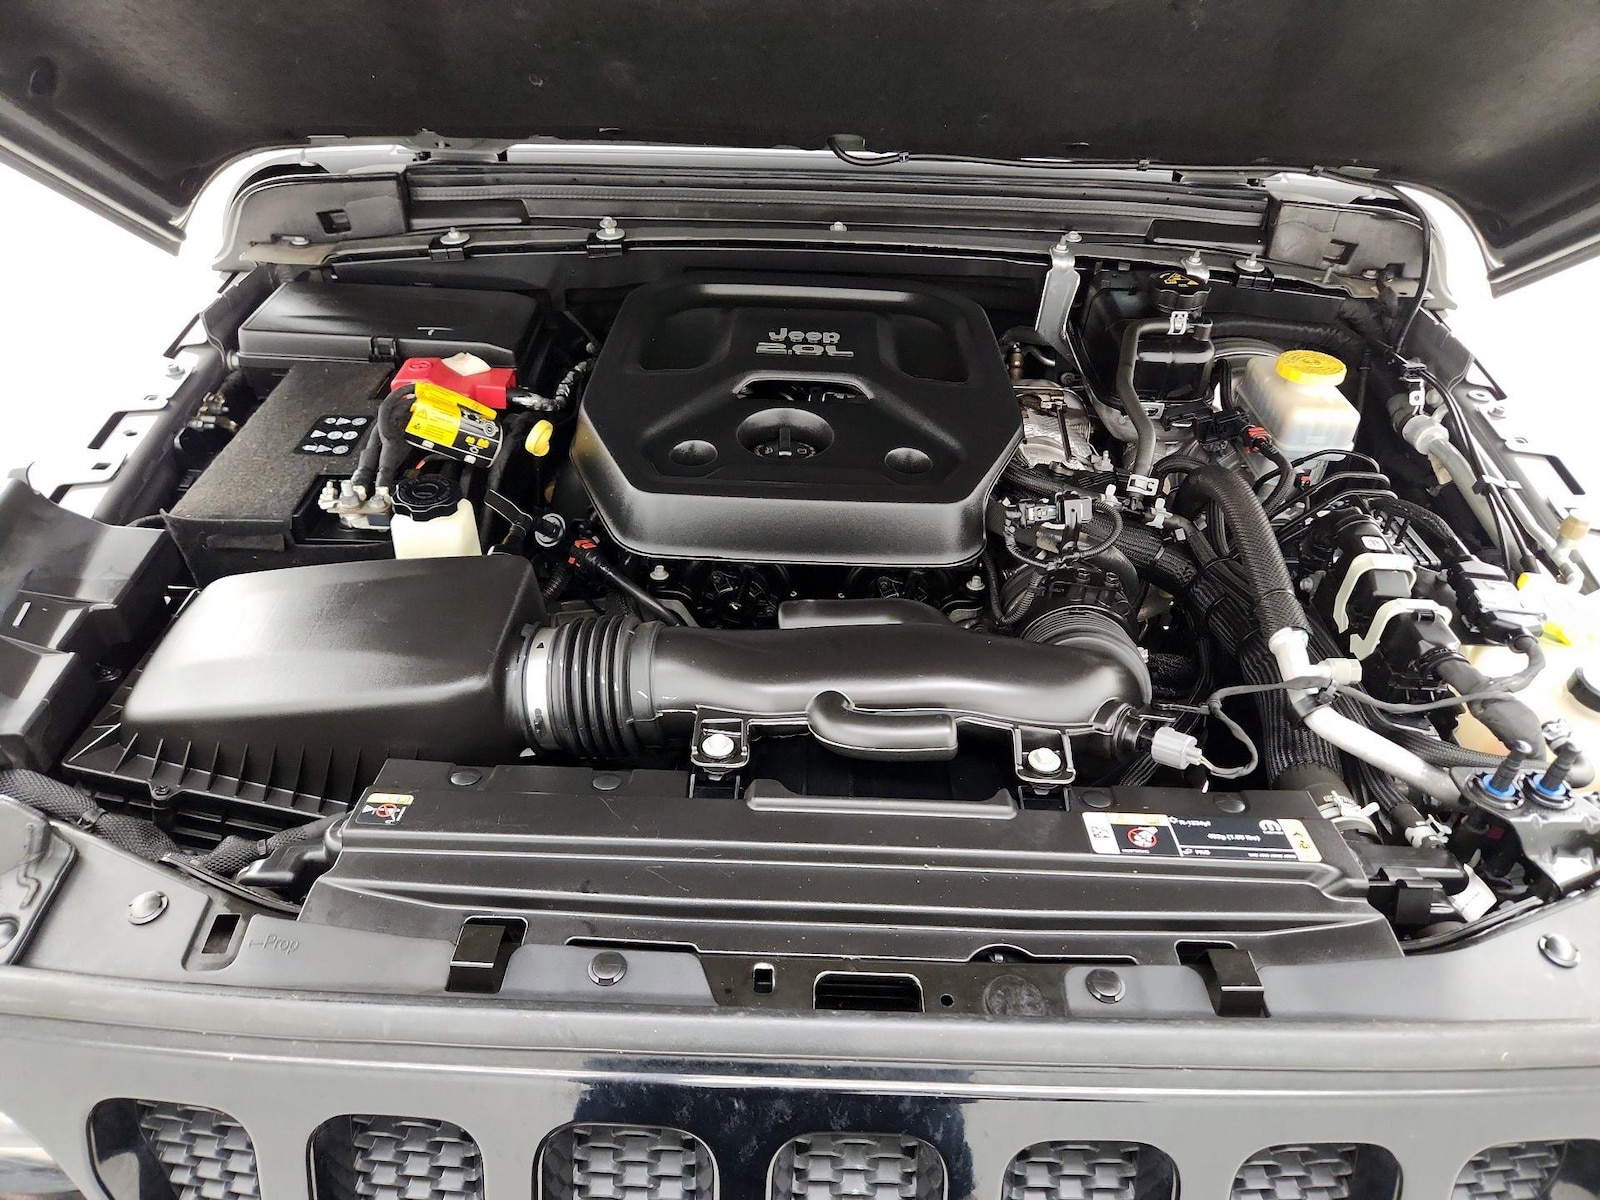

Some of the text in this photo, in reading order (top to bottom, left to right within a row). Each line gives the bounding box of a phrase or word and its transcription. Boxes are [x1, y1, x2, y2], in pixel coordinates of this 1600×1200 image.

[768, 327, 841, 344] Jeep
[756, 341, 855, 358] 2.0L
[263, 934, 300, 956] Prop
